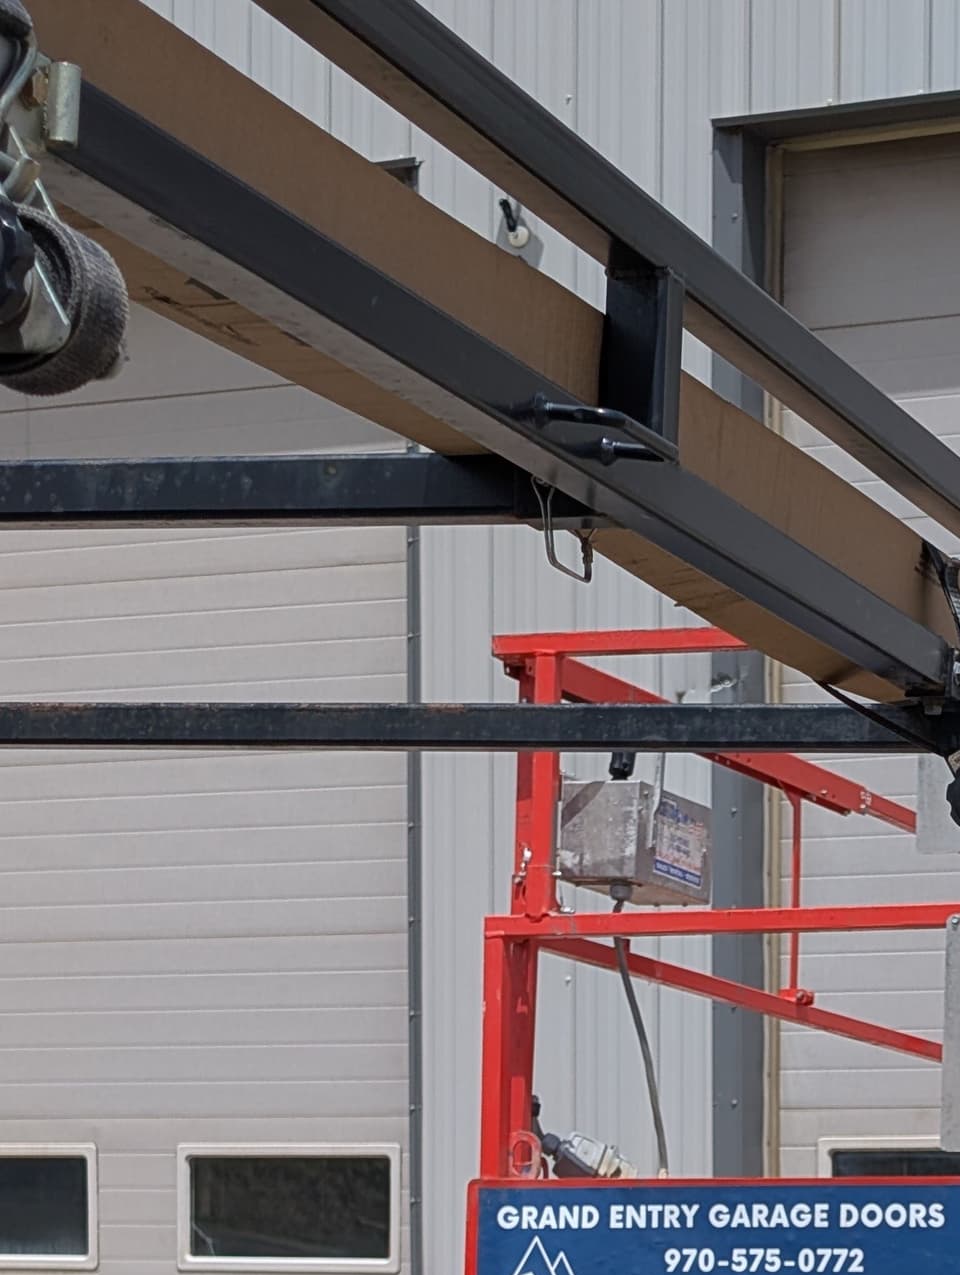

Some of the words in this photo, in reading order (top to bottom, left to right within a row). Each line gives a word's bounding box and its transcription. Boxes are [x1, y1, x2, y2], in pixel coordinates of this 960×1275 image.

[497, 1205, 599, 1230] GRAND
[609, 1204, 700, 1229] ENTRY
[708, 1203, 830, 1228] GARAGE
[839, 1203, 945, 1228] DOORS
[664, 1247, 865, 1273] 970-575-0772
